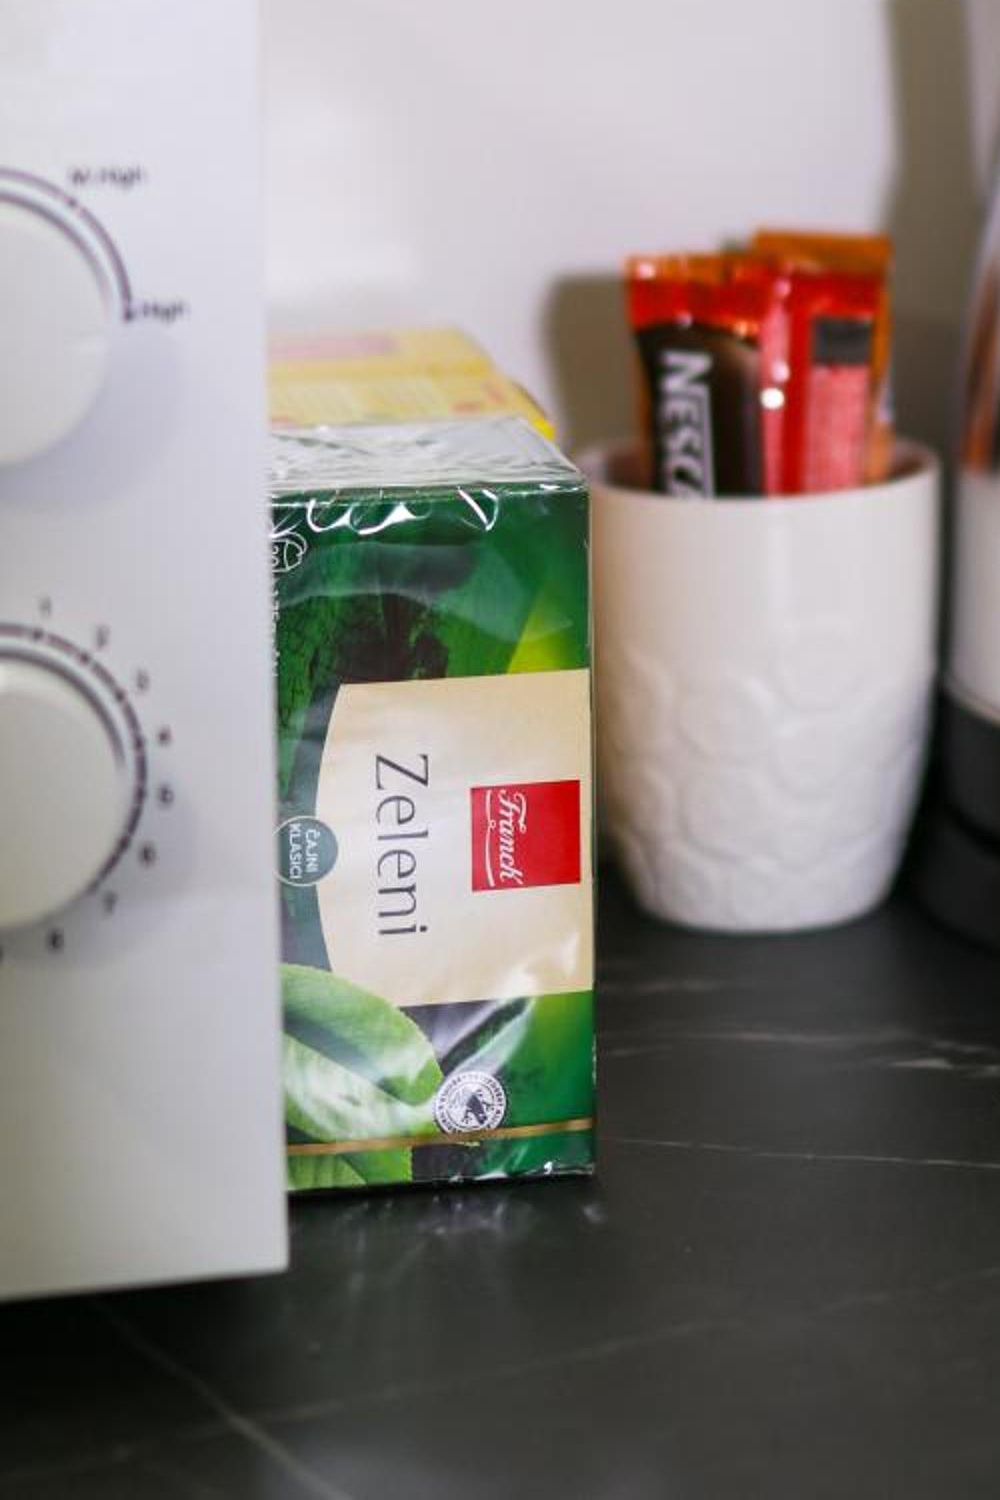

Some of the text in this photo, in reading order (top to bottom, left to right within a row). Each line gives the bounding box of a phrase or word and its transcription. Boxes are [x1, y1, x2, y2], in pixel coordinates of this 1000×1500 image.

[289, 822, 303, 879] KLASICI
[305, 828, 320, 873] ČAJNI
[375, 753, 429, 936] Zeleni
[498, 788, 528, 886] Franck
